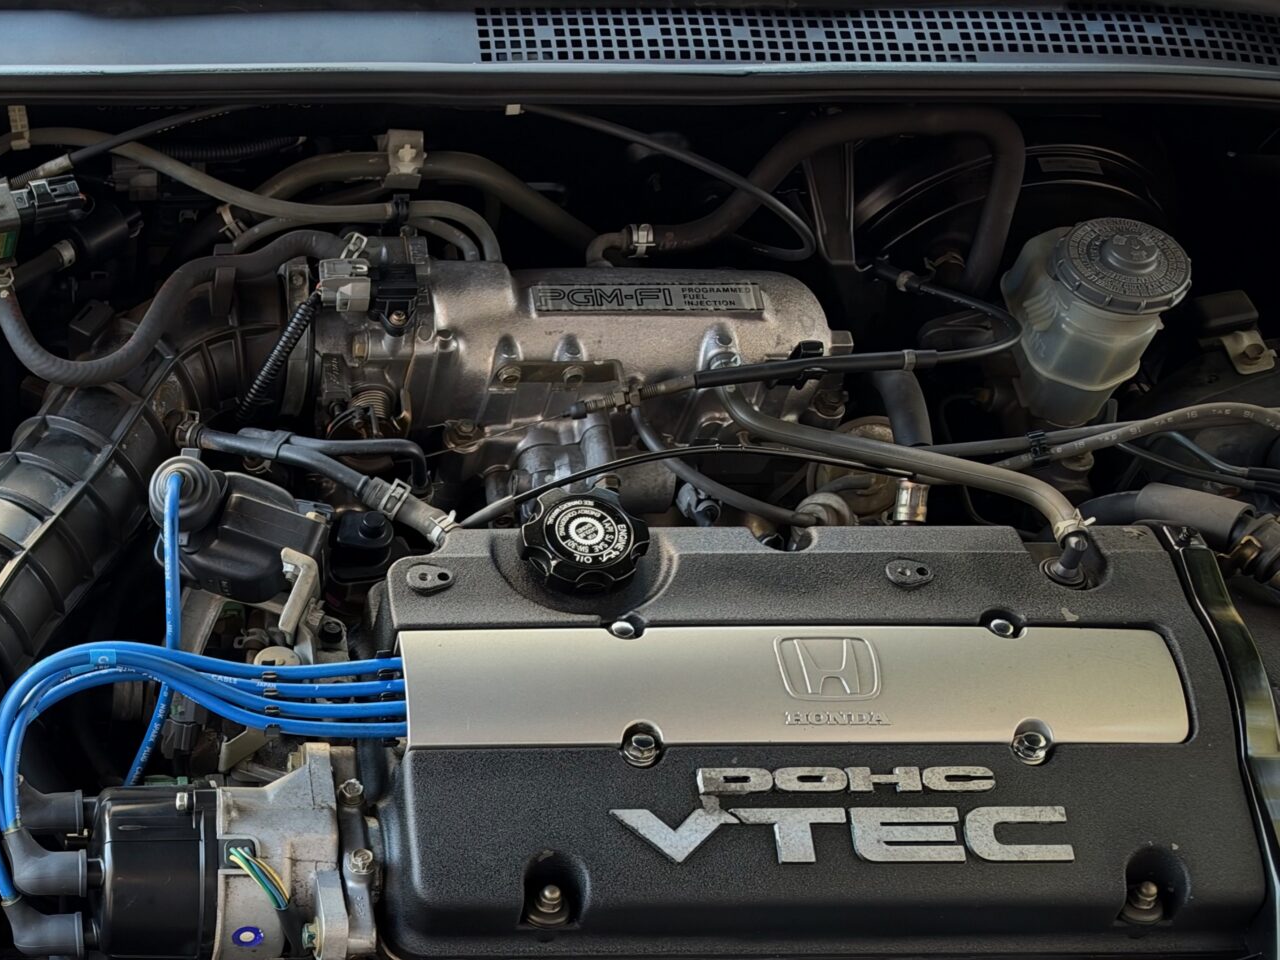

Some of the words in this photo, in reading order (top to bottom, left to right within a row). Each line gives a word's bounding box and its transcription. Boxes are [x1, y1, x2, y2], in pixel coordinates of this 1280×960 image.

[538, 288, 673, 307] PGM-FI
[592, 541, 608, 553] SAE
[613, 524, 628, 552] ENGINE
[573, 553, 592, 564] OIL
[784, 711, 892, 726] HONDA
[697, 766, 996, 793] DOHC
[608, 805, 1075, 863] VTEC
